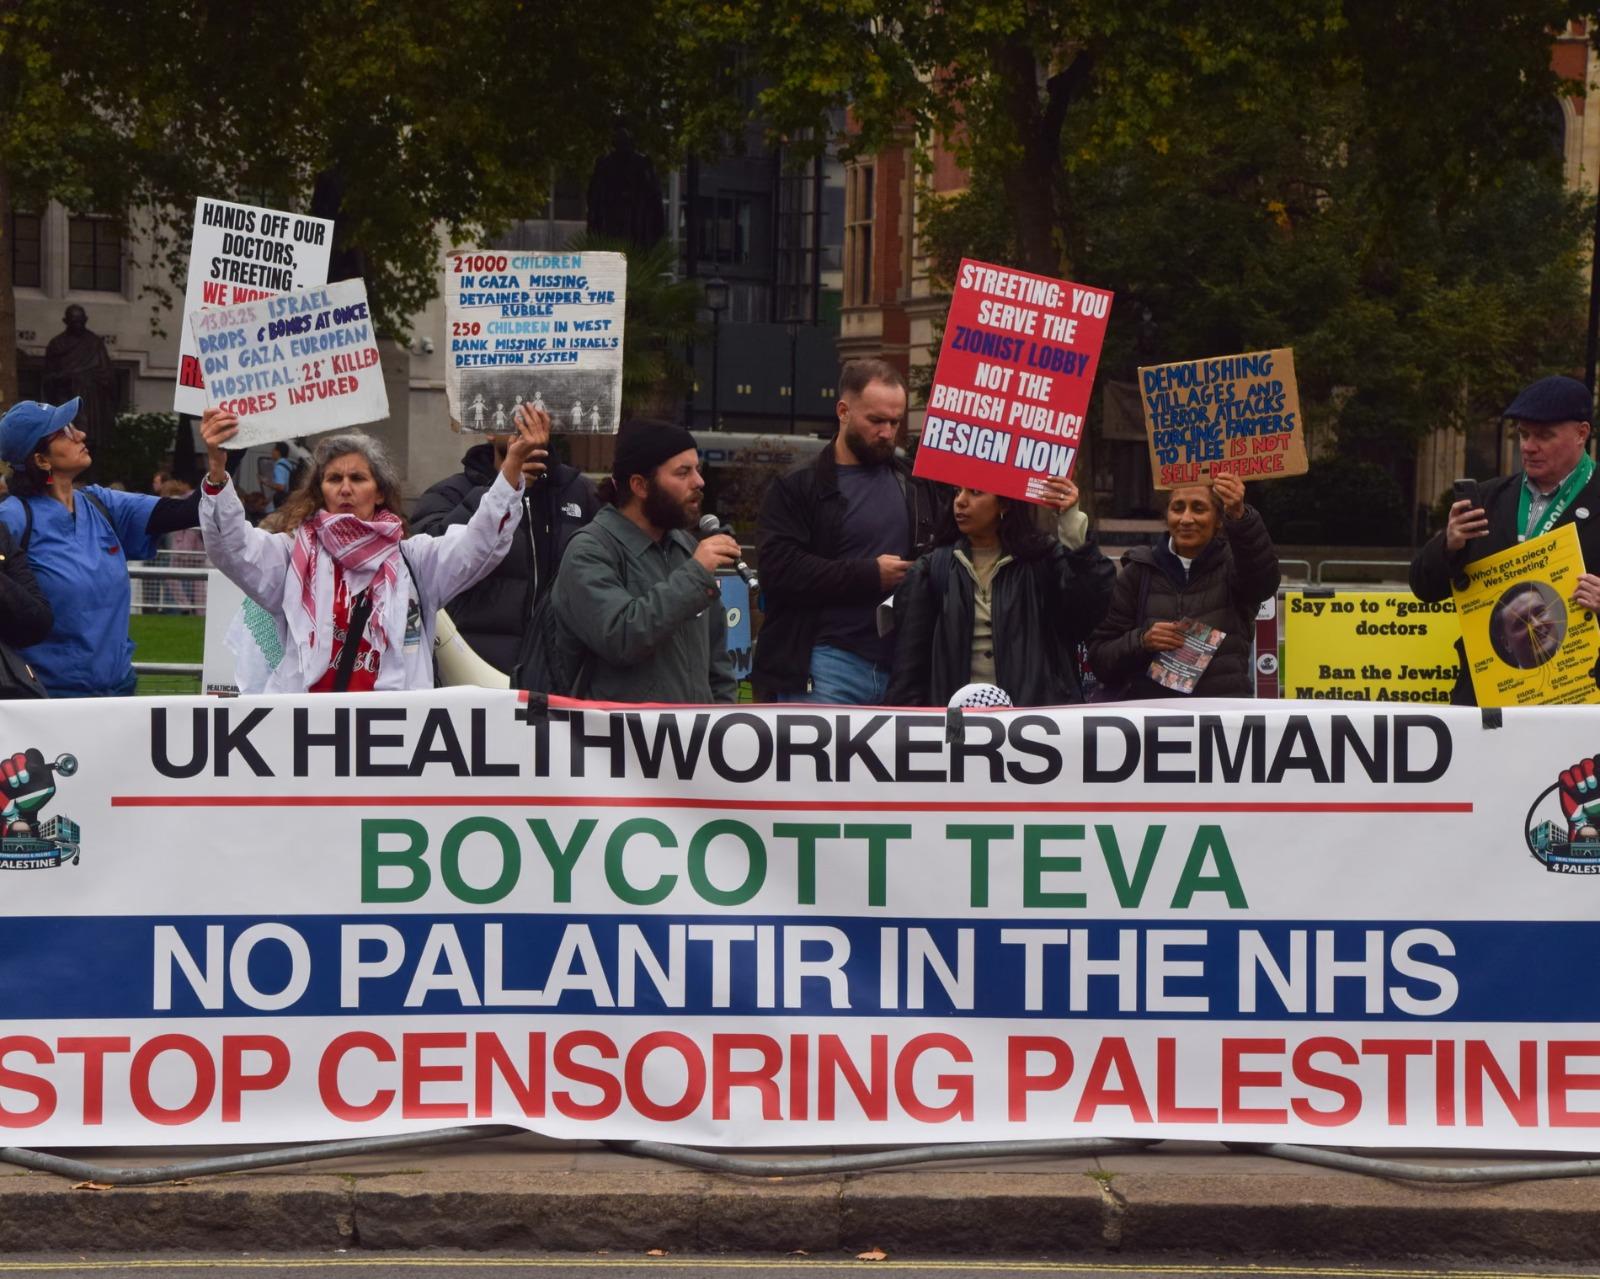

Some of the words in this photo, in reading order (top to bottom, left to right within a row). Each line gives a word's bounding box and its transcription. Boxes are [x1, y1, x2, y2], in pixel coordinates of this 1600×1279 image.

[202, 203, 256, 234] HANDS
[260, 214, 290, 238] OFF
[293, 220, 326, 246] OUR
[222, 233, 298, 270] DOCTORS,
[453, 255, 508, 273] 21000
[511, 255, 582, 270] CHILDREN
[210, 257, 293, 292] STREETING
[461, 276, 474, 288] IN
[479, 275, 520, 289] GAZA
[960, 264, 1065, 308] STREETING:
[1071, 288, 1109, 319] YOU
[203, 281, 227, 306] WE
[267, 290, 333, 319] ISRAEL
[460, 292, 531, 306] DETAINED
[535, 292, 581, 304] UNDER
[587, 291, 615, 303] THE
[501, 304, 553, 317] RUBBLE
[199, 329, 247, 354] DROPS
[314, 311, 331, 331] AT
[333, 302, 368, 325] ONCE
[452, 322, 480, 336] 250
[486, 322, 550, 335] CHILDREN
[554, 321, 568, 332] IN
[573, 320, 612, 331] WEST
[977, 300, 1038, 336] SERVE
[1042, 314, 1078, 344] THE
[204, 356, 229, 375] ON
[238, 344, 285, 368] GAZA
[291, 325, 368, 358] EUROPEAN
[452, 339, 489, 351] BANK
[495, 339, 547, 350] MISSING
[552, 338, 566, 348] IN
[570, 337, 619, 348] ISRAEL'S
[455, 353, 524, 366] DETENTION
[528, 351, 578, 363] SYSTEM
[951, 325, 1025, 364] ZIONIST
[1027, 343, 1090, 378] LOBBY
[331, 348, 379, 376] KILLED
[1143, 353, 1274, 395] DEMOLISHING
[219, 392, 276, 417] SCORES
[288, 375, 359, 406] INJURED
[974, 362, 1014, 393] NOT
[1018, 371, 1053, 402] THE
[1147, 383, 1235, 413] VILLAGES
[1247, 380, 1283, 399] AND
[931, 384, 1006, 423] BRITISH
[1008, 401, 1082, 440] PUBLIC!
[1150, 406, 1210, 430] TERROR
[1214, 394, 1286, 424] ATTACKS
[922, 415, 1011, 464] RESIGN
[1013, 436, 1076, 478] NOW
[1153, 421, 1223, 449] FORCING
[1226, 413, 1295, 440] FARMERS
[1156, 448, 1179, 466] TO
[1186, 440, 1224, 464] FLEE
[1230, 440, 1247, 457] IS
[1252, 433, 1291, 455] NOT
[1470, 564, 1498, 582] Who's
[1499, 560, 1514, 575] got
[1515, 557, 1521, 565] a
[1522, 546, 1546, 564] piece
[1547, 540, 1558, 552] of
[1484, 575, 1502, 588] Wes
[1503, 556, 1550, 581] Streeting?
[1291, 599, 1326, 617] Say
[1331, 601, 1355, 613] no
[1360, 599, 1379, 613] to
[1385, 598, 1457, 617] “genoci
[1355, 620, 1428, 636] doctors
[1319, 665, 1356, 680] Ban
[1361, 664, 1392, 680] the
[1295, 687, 1370, 701] Medical
[151, 707, 276, 779] UK
[293, 707, 1063, 785] HEALTHWORKERS
[1082, 714, 1453, 784] DEMAND
[0, 858, 56, 869] ALESTINE
[361, 816, 912, 907] BOYCOTT
[945, 823, 1249, 909] TEVA
[1553, 863, 1560, 872] 4
[153, 922, 311, 1010] NO
[340, 923, 852, 1009] PALANTIR
[880, 927, 975, 1010] IN
[1000, 928, 1209, 1012] THE
[1238, 928, 1459, 1016] NHS
[0, 1033, 291, 1129] STOP
[318, 1030, 974, 1123] CENSORING
[1007, 1035, 1600, 1128] PALESTINE
